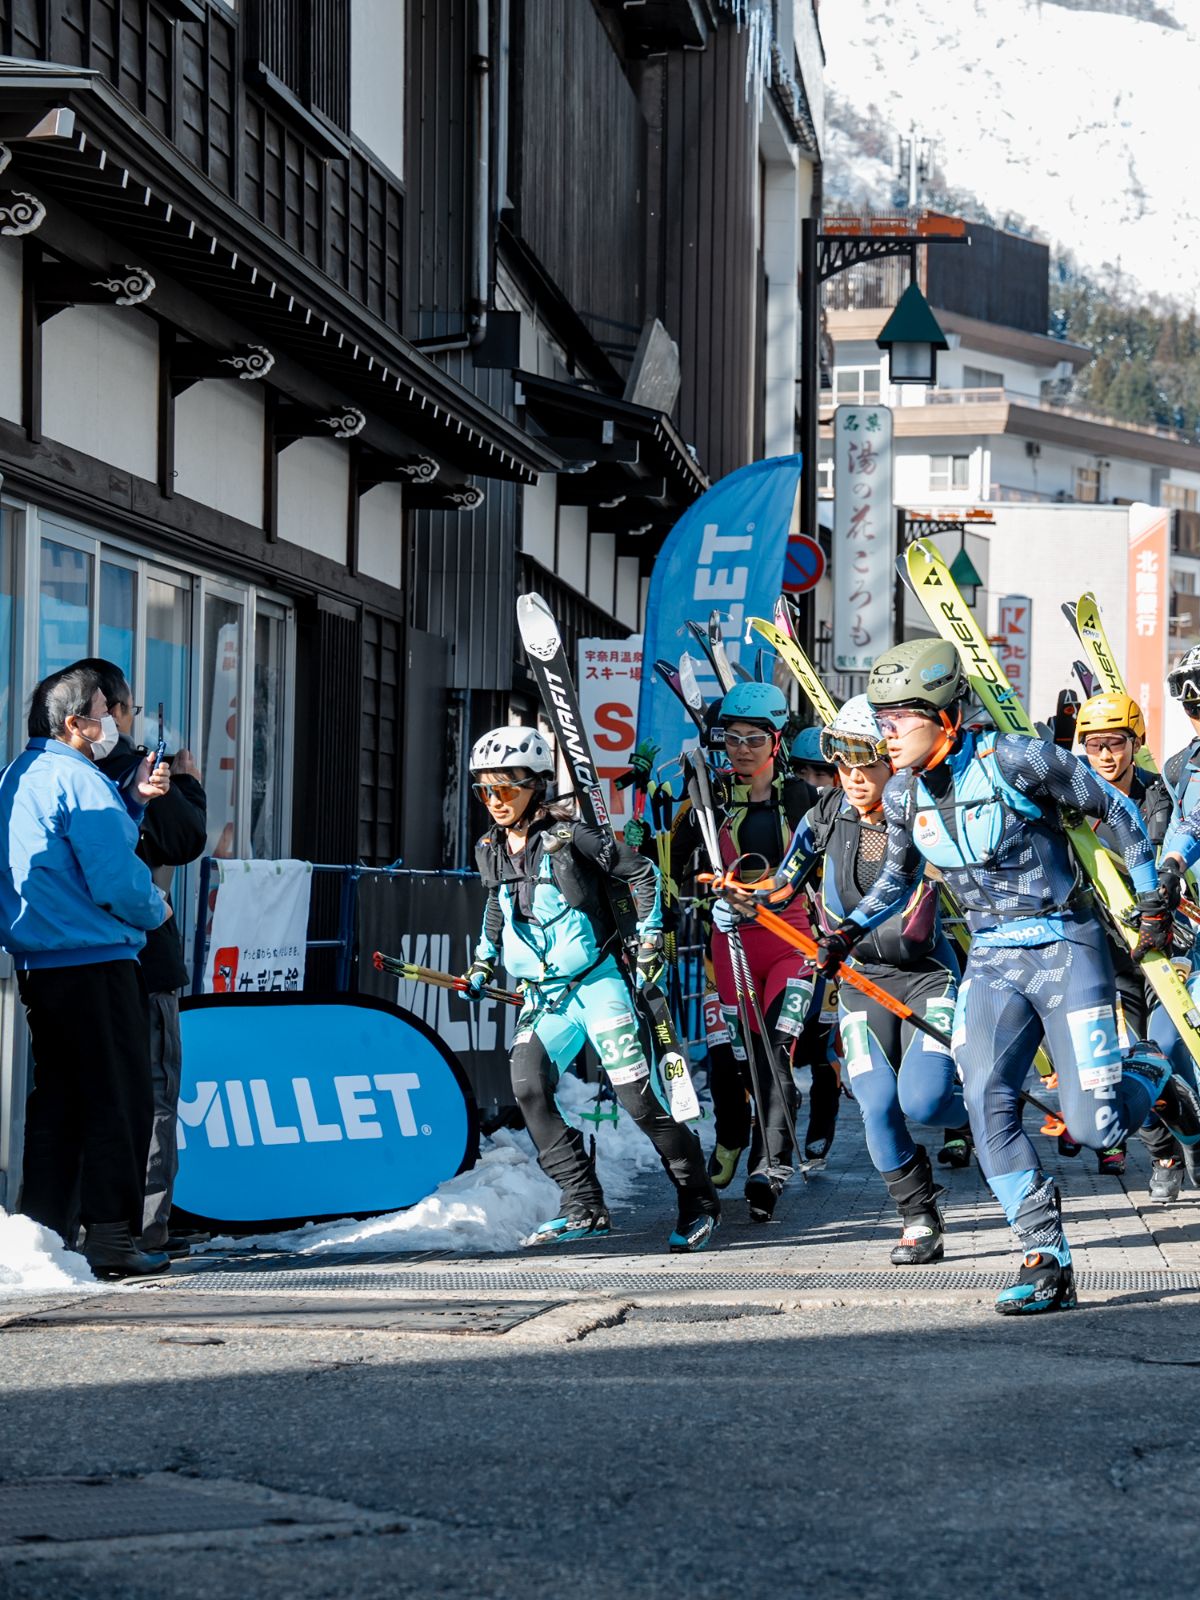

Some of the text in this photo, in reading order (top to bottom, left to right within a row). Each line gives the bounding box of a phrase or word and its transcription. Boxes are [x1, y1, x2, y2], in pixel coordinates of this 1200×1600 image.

[586, 667, 641, 680] スキー場
[940, 601, 1029, 732] FISCHER
[1092, 641, 1123, 694] HER
[543, 666, 597, 788] DYNAFIT
[920, 831, 936, 840] JAPAN
[786, 993, 811, 1018] 30
[601, 1033, 639, 1063] 32
[1090, 1029, 1111, 1058] 2
[664, 1058, 684, 1081] 64
[177, 1073, 420, 1149] MILLET
